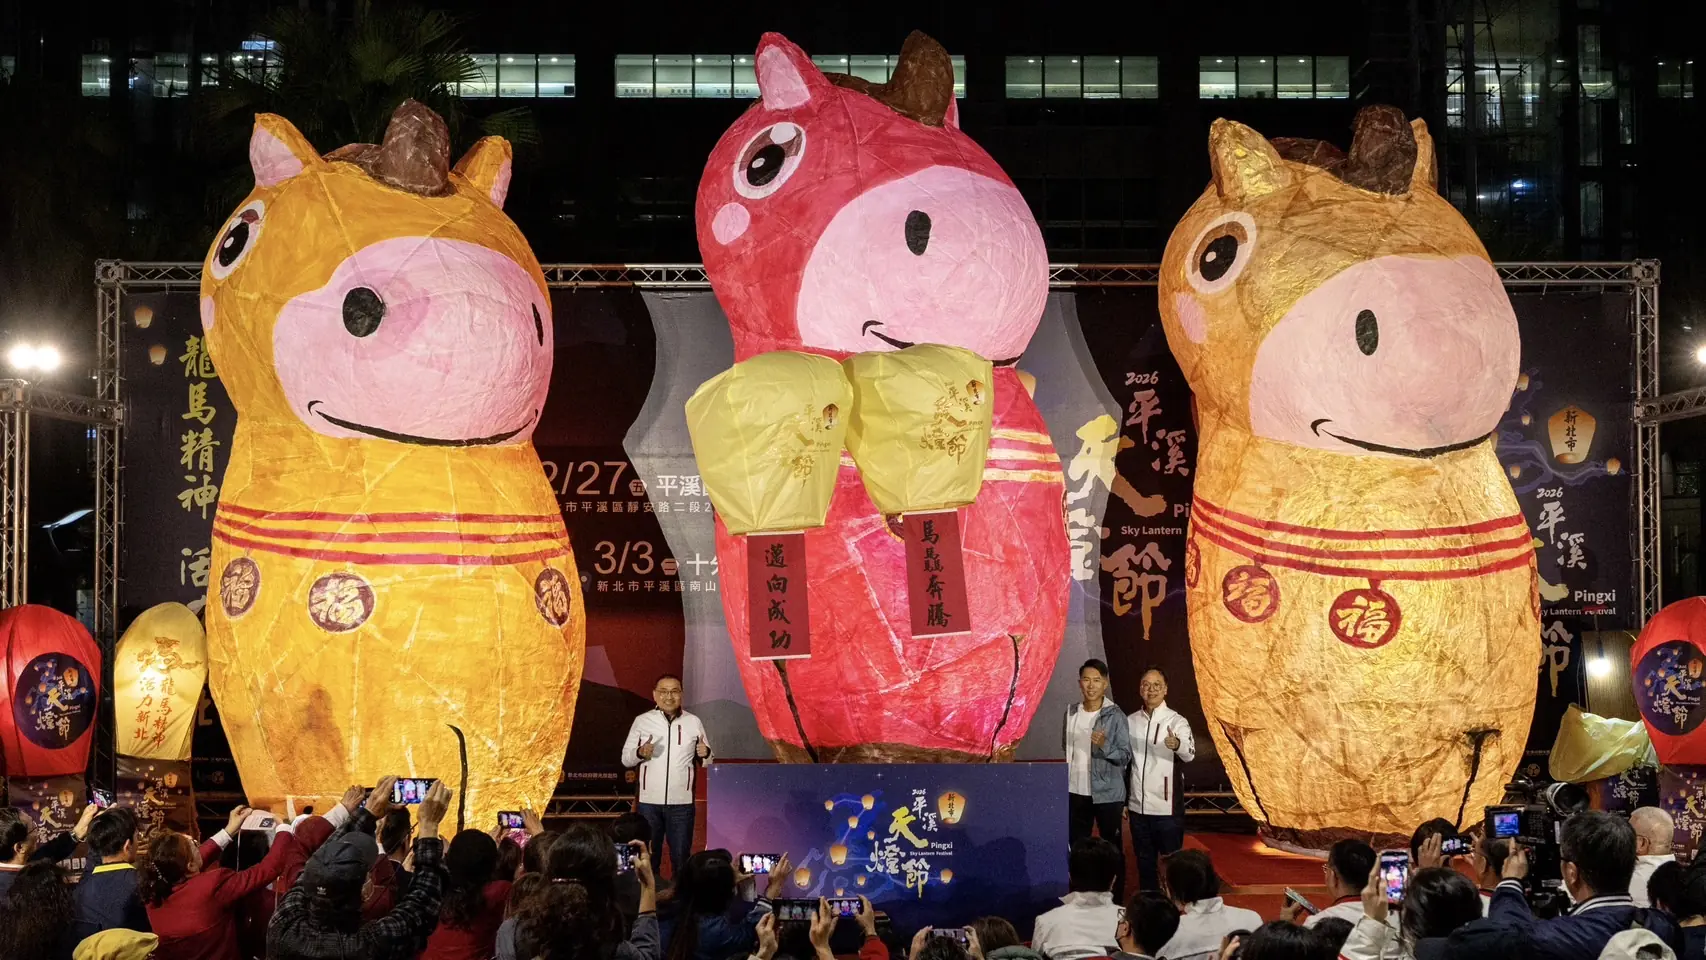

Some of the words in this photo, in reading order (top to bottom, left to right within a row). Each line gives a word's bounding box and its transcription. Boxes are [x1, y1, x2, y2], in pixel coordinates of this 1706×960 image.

[1125, 372, 1159, 385] 2026
[177, 335, 220, 520] 龍馬精神
[1126, 389, 1189, 477] 平溪
[1564, 410, 1578, 452] 新北市
[656, 475, 710, 497] 平溪
[1537, 487, 1563, 498] 2026
[559, 501, 711, 513] 市平溪區靜安路二段2
[1121, 526, 1140, 536] Sky
[1143, 525, 1182, 535] Lantern
[1537, 501, 1587, 569] 平溪
[594, 541, 654, 574] 3/3
[310, 577, 366, 626] 福
[597, 580, 716, 592] 新北市平溪區南山
[765, 543, 792, 650] 邁向成功
[1574, 590, 1616, 605] Pingxi
[1338, 595, 1391, 643] 福
[35, 687, 71, 740] 天燈節
[133, 676, 157, 741] 活力新北
[912, 796, 938, 832] 平溪
[865, 806, 931, 898] 天燈節
[930, 842, 953, 850] Pingxi
